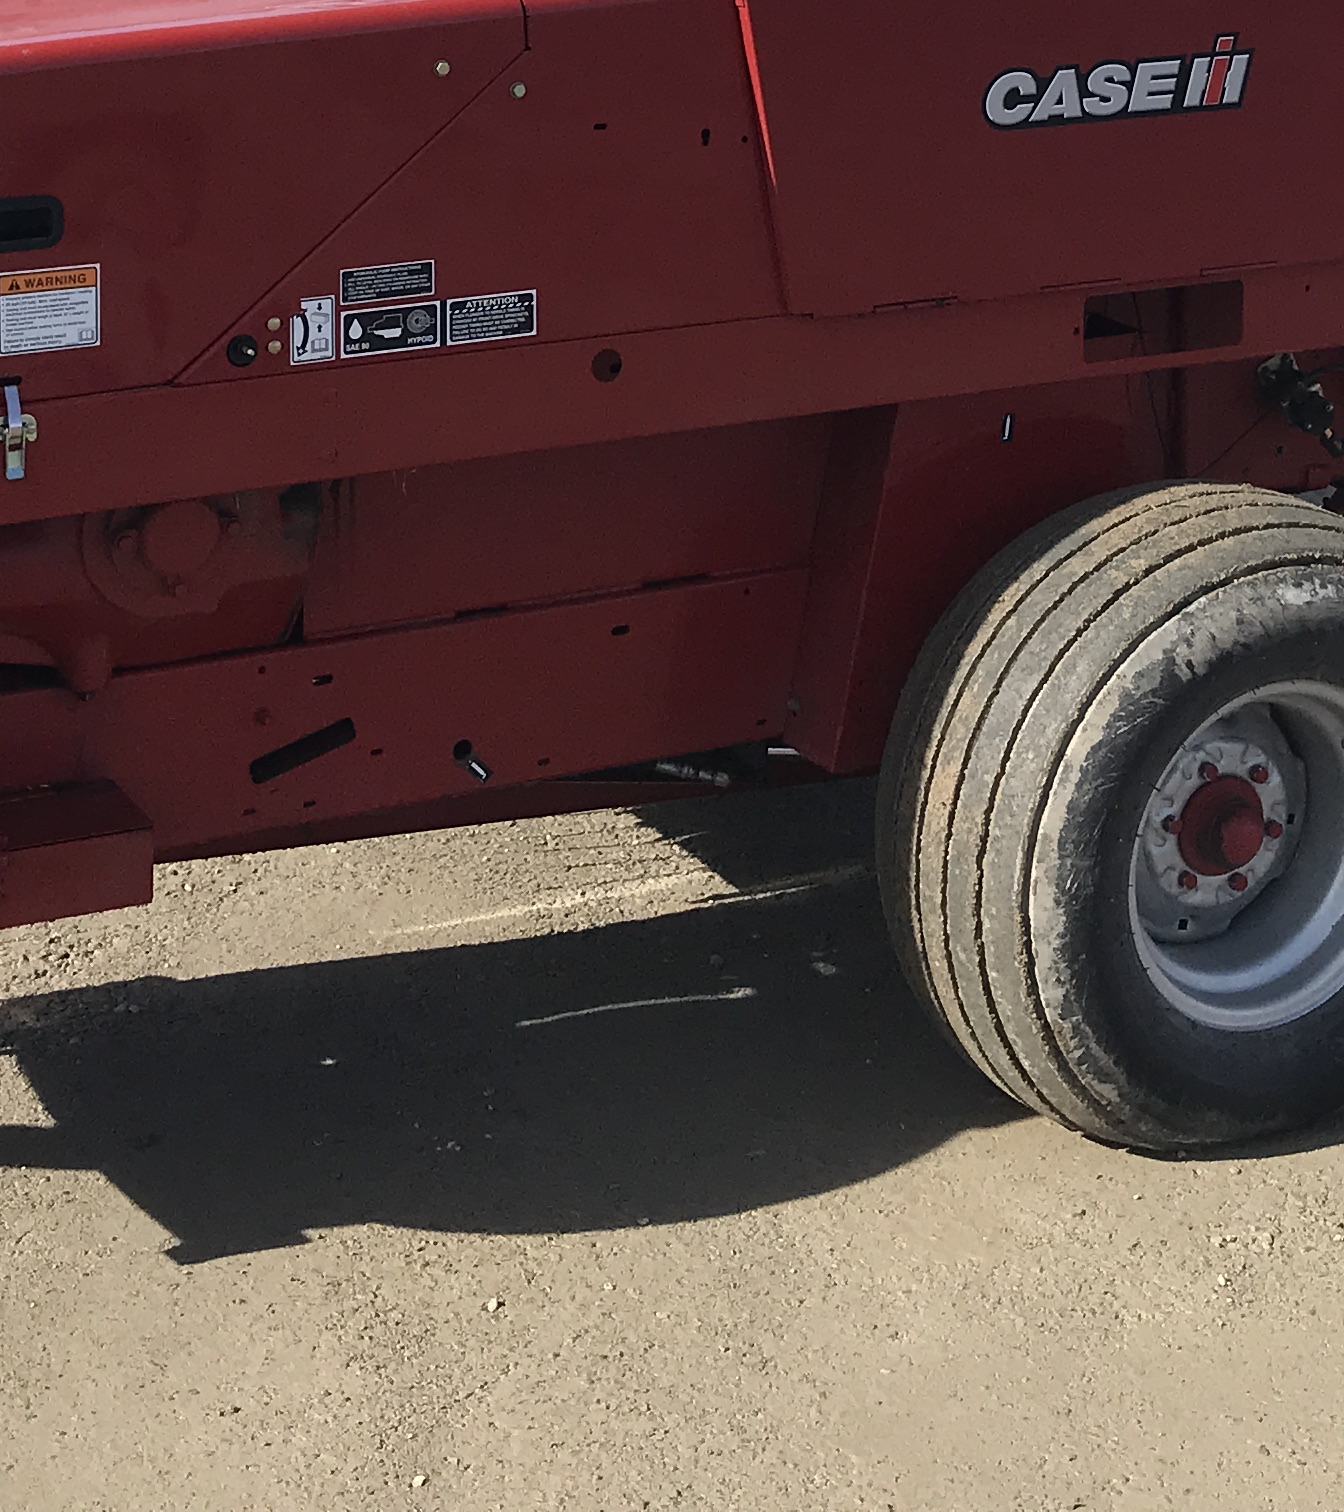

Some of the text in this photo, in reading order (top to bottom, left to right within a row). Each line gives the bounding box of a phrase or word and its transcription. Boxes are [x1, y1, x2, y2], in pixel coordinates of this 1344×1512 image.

[984, 58, 1183, 127] CASE
[24, 273, 87, 288] WARNING
[465, 296, 519, 308] ATTENTION
[407, 335, 434, 345] HYPOID
[346, 343, 360, 352] SAE
